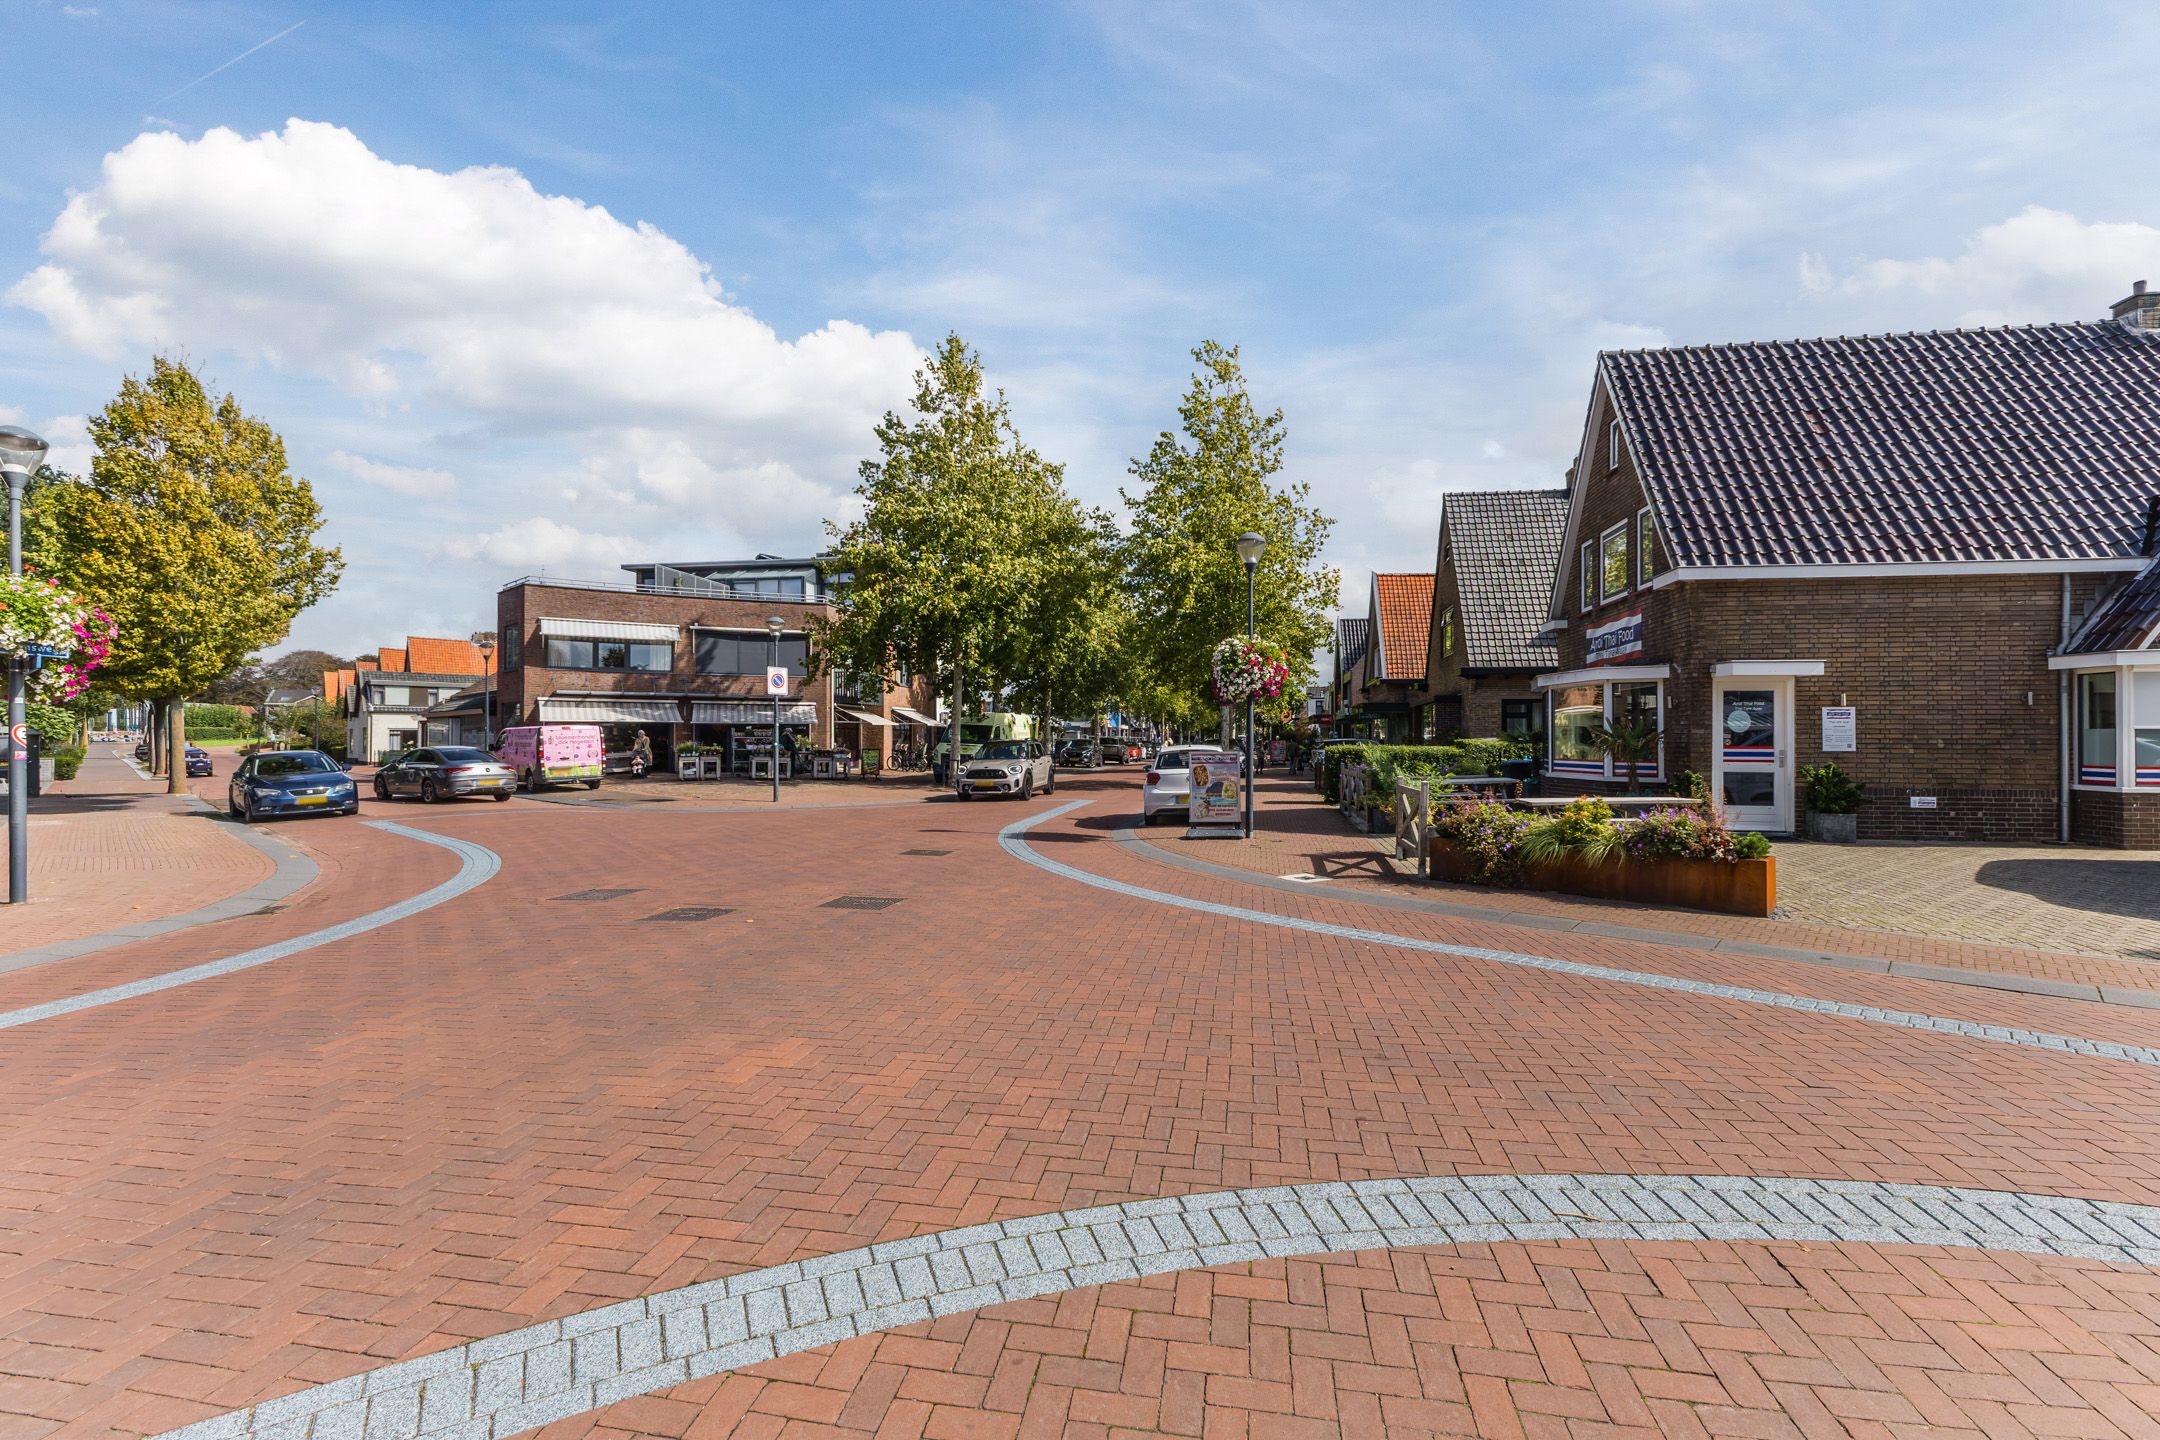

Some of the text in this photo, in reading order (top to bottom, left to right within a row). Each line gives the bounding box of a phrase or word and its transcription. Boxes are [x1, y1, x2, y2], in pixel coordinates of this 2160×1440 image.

[1590, 626, 1634, 652] Aroi Thai Food
